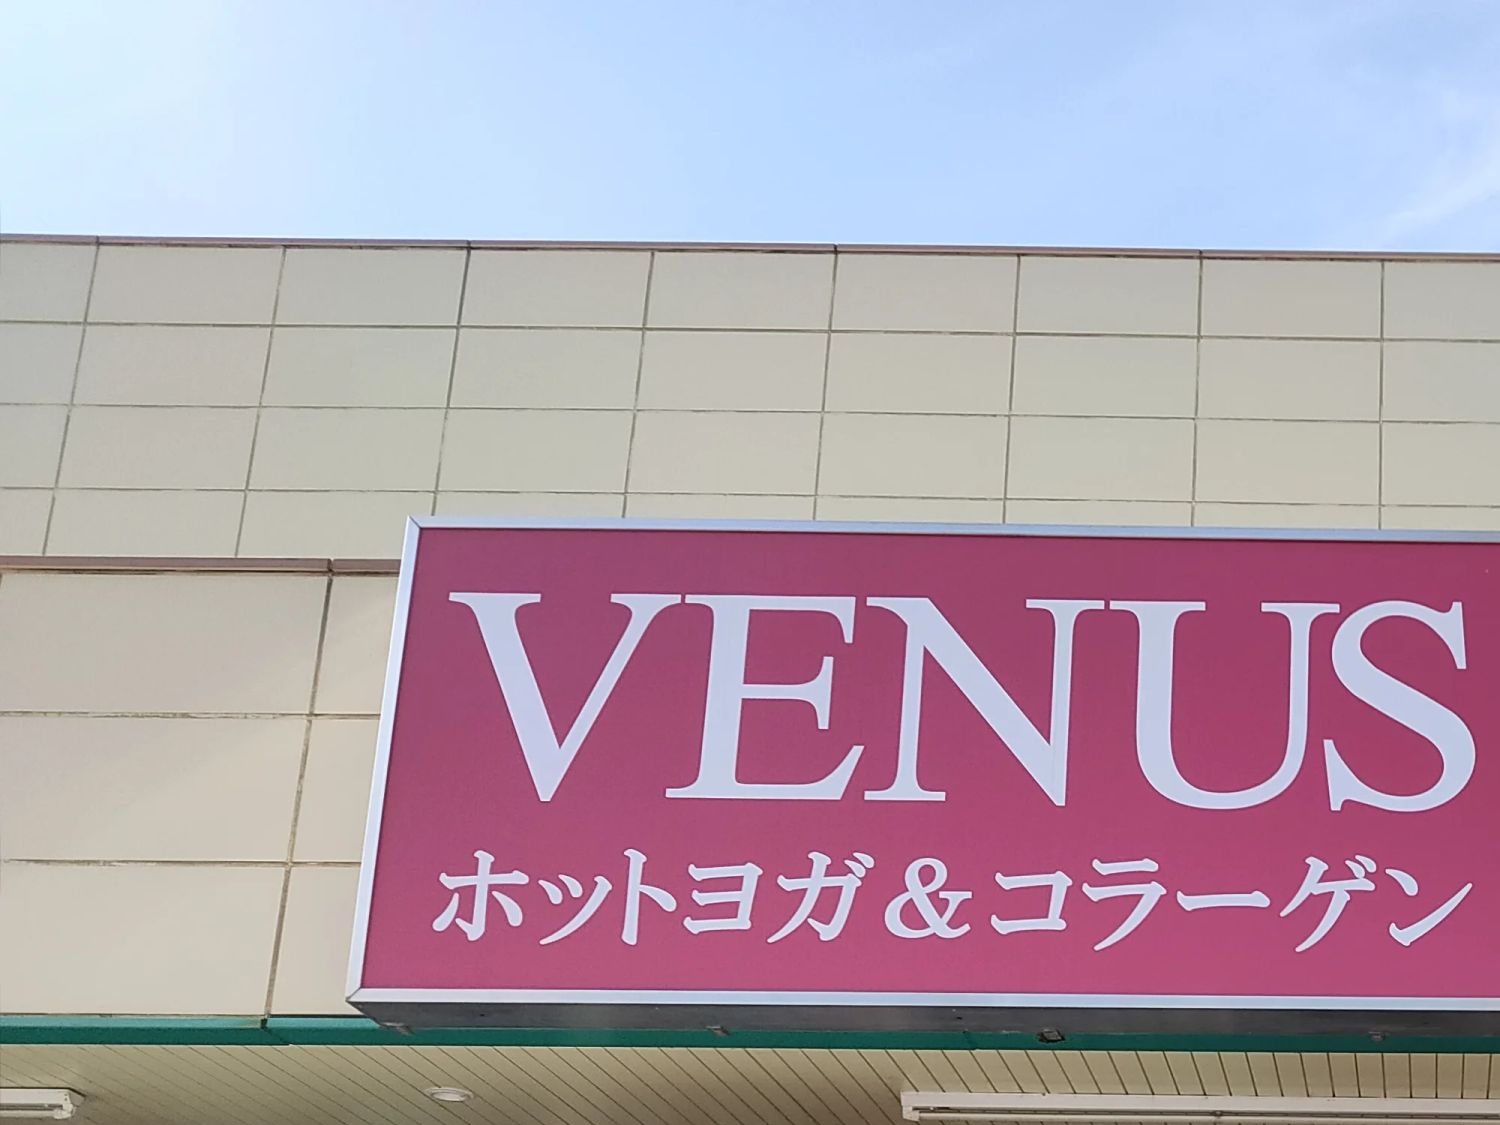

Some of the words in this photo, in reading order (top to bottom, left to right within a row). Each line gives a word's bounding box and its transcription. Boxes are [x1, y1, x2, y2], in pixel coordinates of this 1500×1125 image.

[449, 592, 1476, 812] VENUS
[432, 849, 1473, 953] ホットヨガ&コラーゲン
